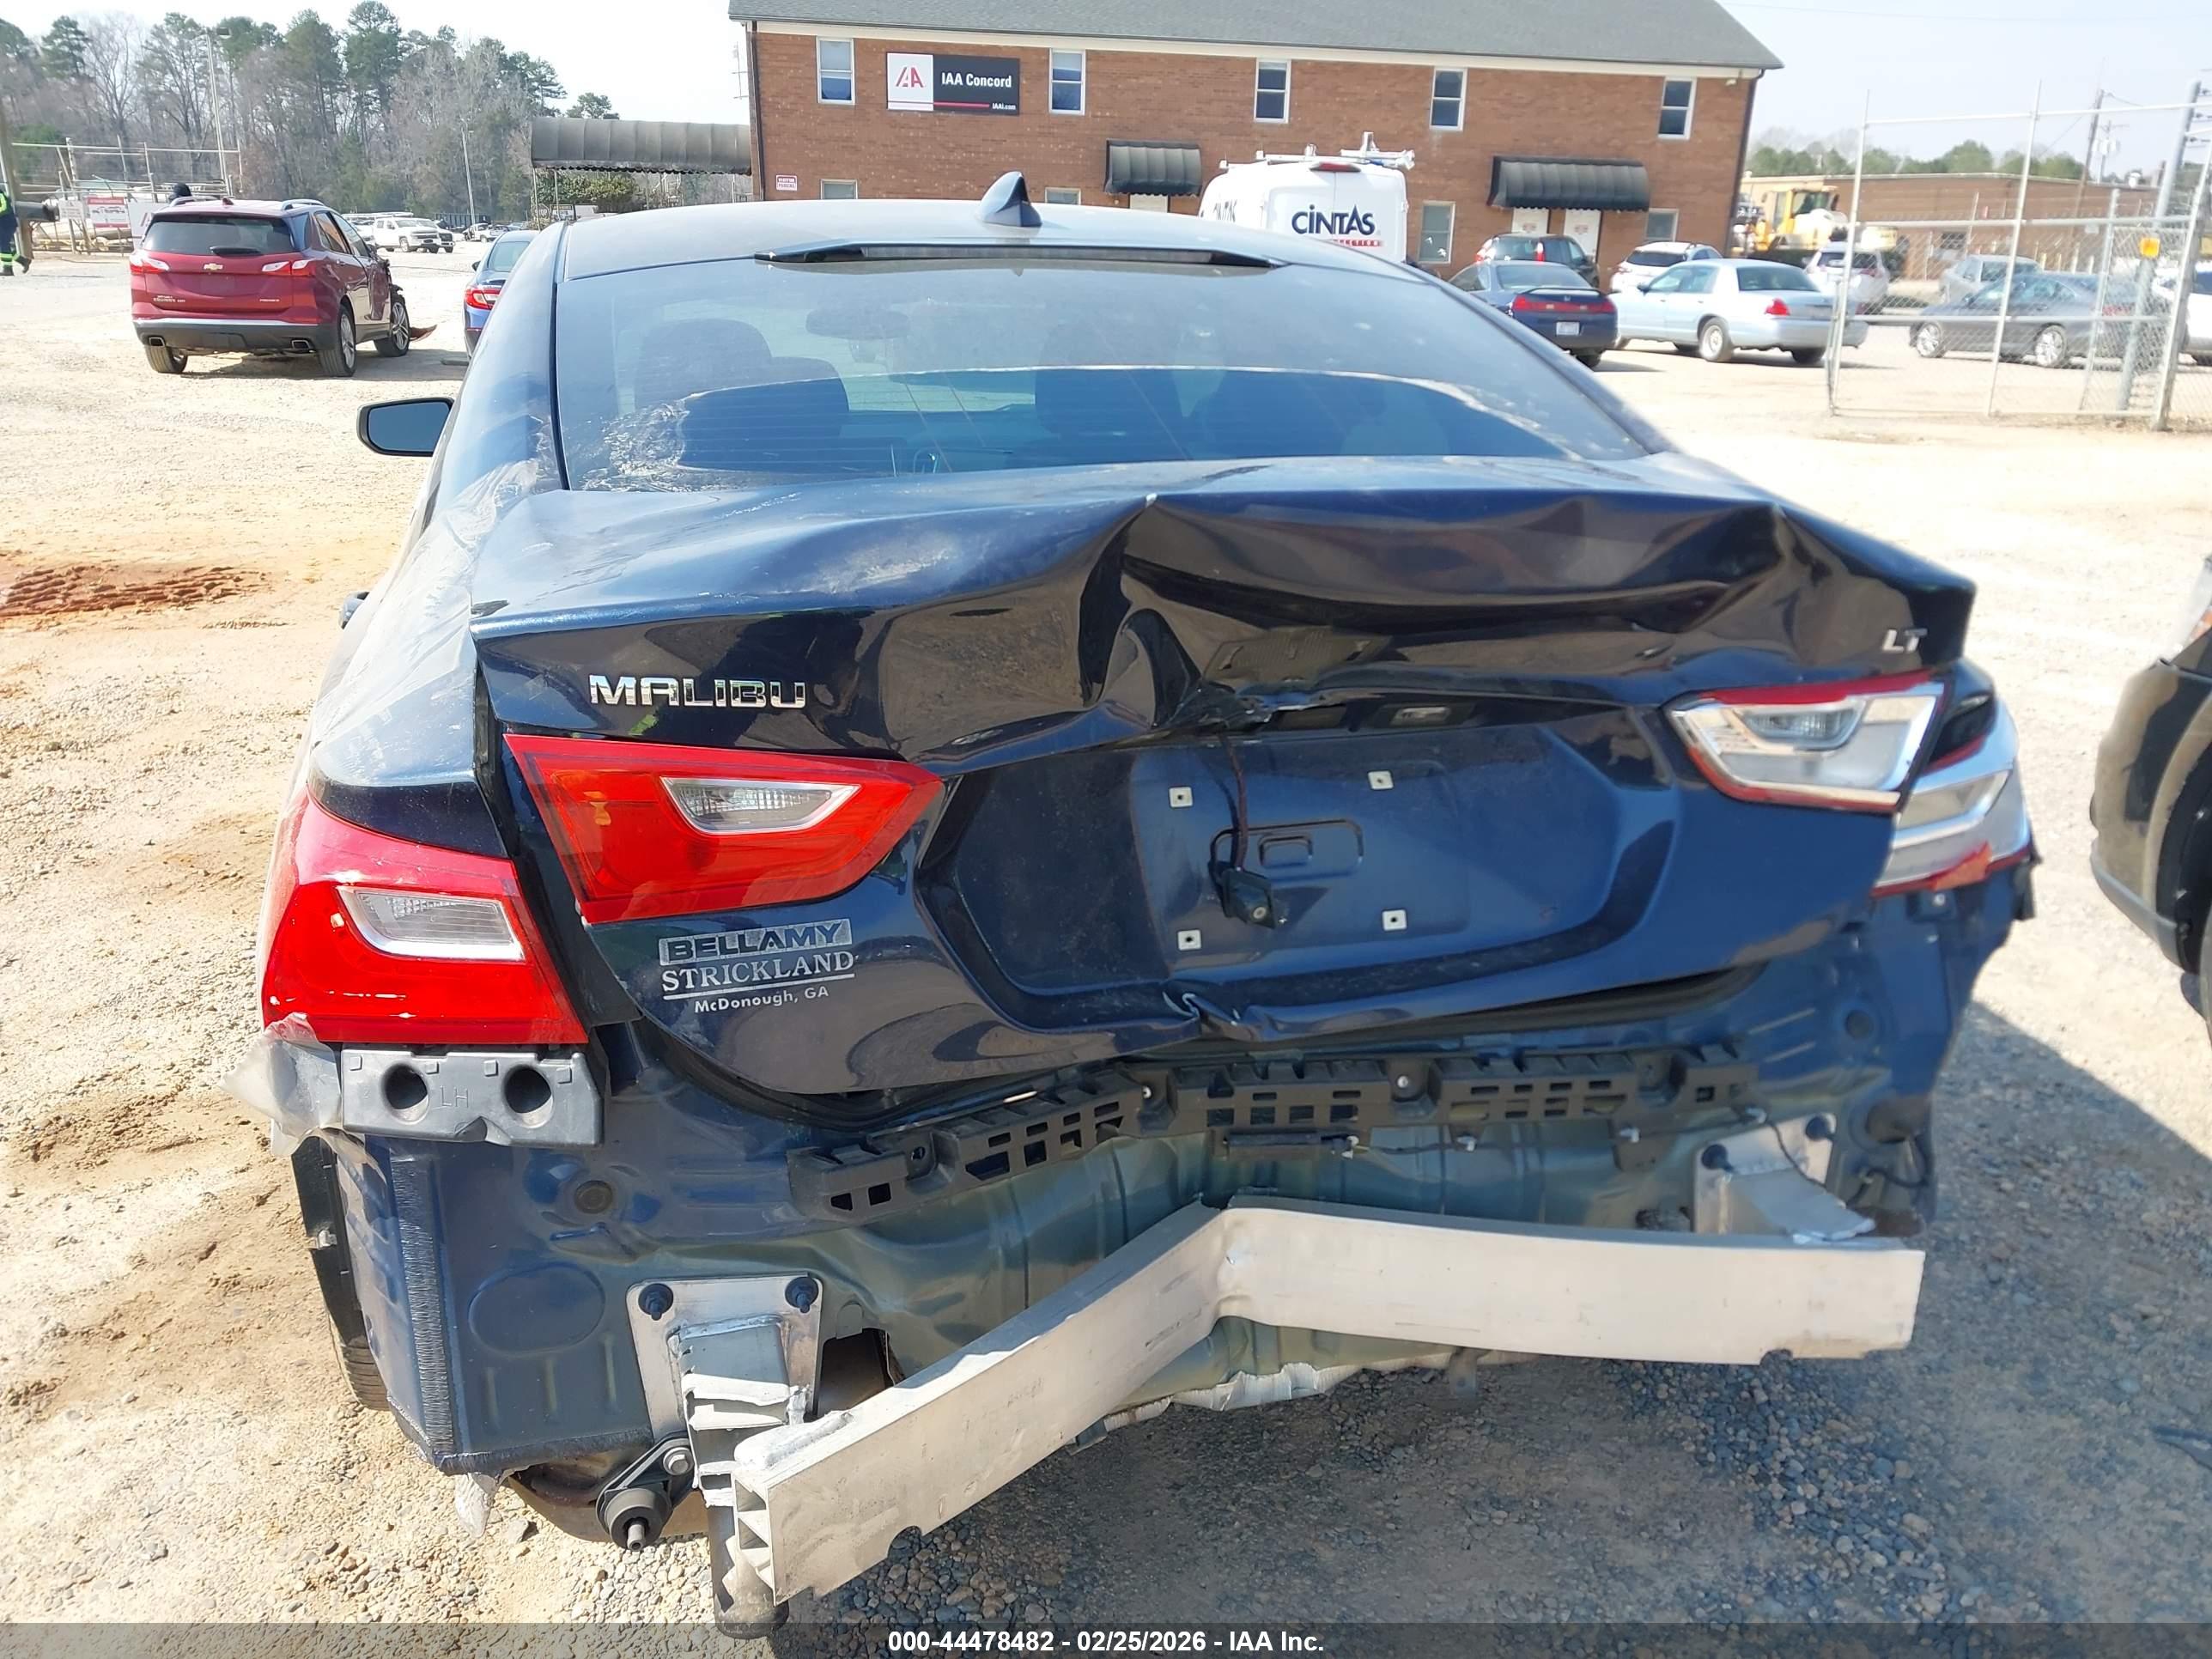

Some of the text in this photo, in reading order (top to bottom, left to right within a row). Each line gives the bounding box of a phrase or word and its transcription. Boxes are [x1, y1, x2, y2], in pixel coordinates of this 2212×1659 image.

[941, 72, 1012, 88] IAA Concord
[1882, 629, 1928, 652] LT
[589, 675, 806, 708] MALIBU
[666, 923, 842, 960] BELLAMY
[662, 951, 854, 992] STRICKLAND
[695, 987, 829, 1013] McDonough, GA
